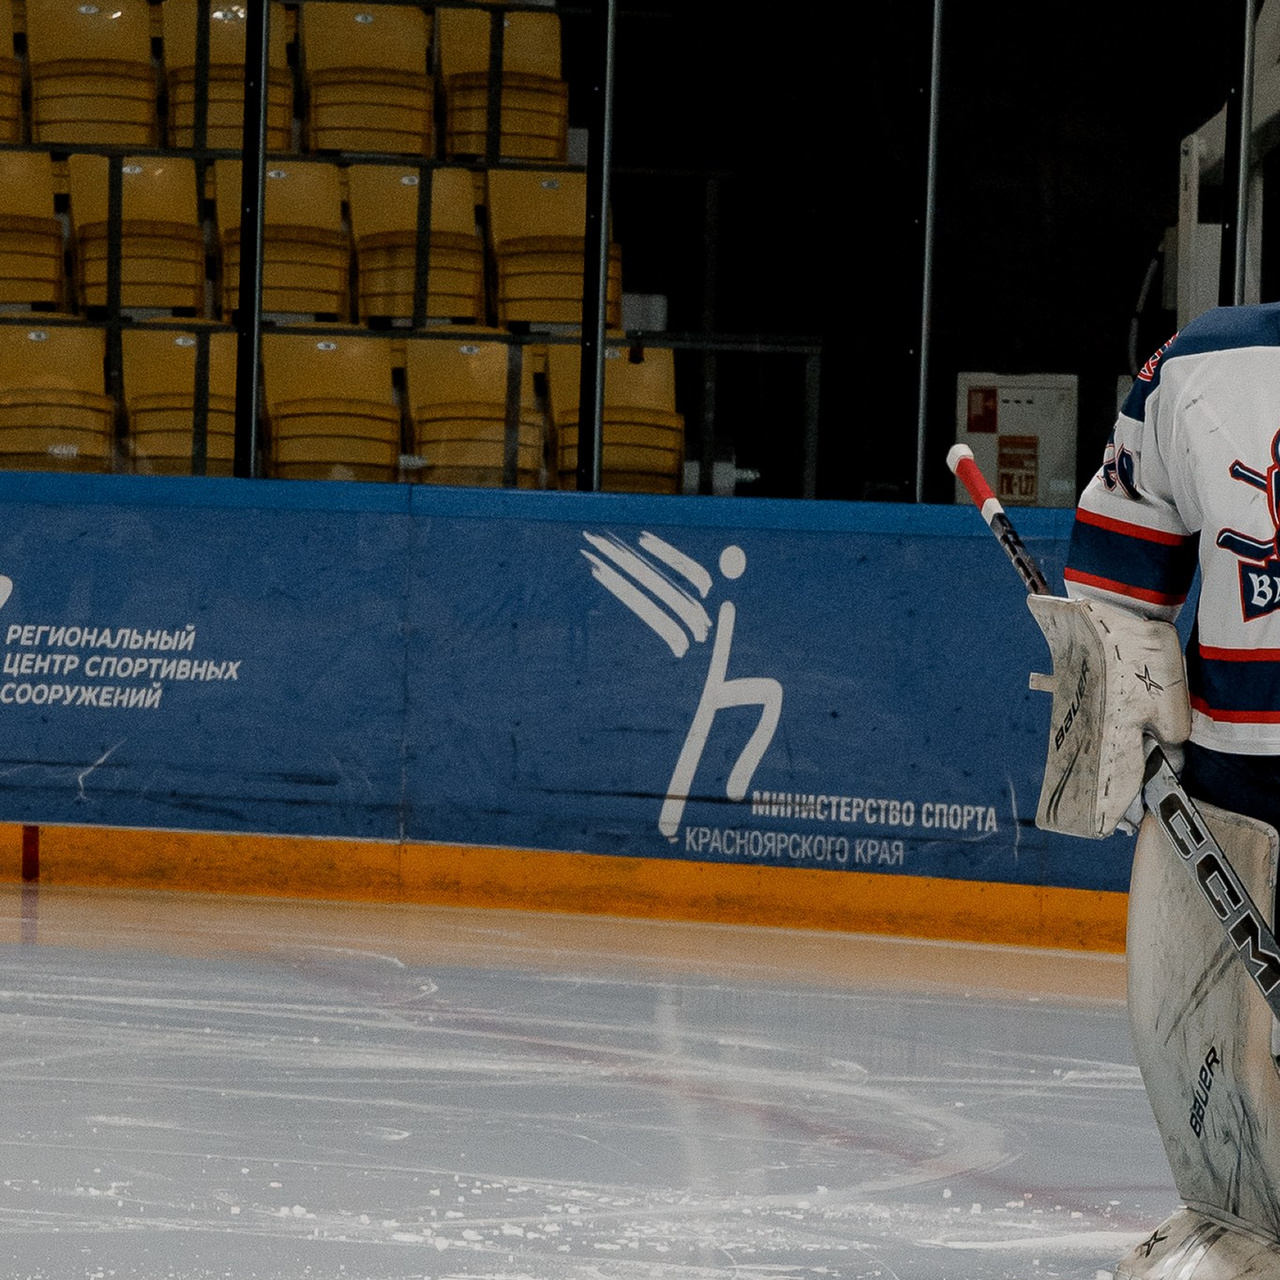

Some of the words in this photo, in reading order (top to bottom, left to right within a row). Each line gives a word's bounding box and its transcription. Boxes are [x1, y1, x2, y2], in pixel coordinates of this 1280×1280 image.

[6, 623, 196, 651] РЕГИОНАЛЬНЫЙ
[3, 652, 80, 677] ЦЕНТР
[84, 656, 242, 682] СПОРТИВНЫХ
[0, 681, 164, 709] СООРУЖЕНИЙ
[752, 790, 915, 827] МИНИСТЕРСТВО
[921, 801, 999, 833] СПОРТА
[685, 826, 849, 863] КРАСНОЯРСКОГО
[854, 839, 905, 866] КРАЯ
[1188, 1045, 1220, 1139] BAUER
